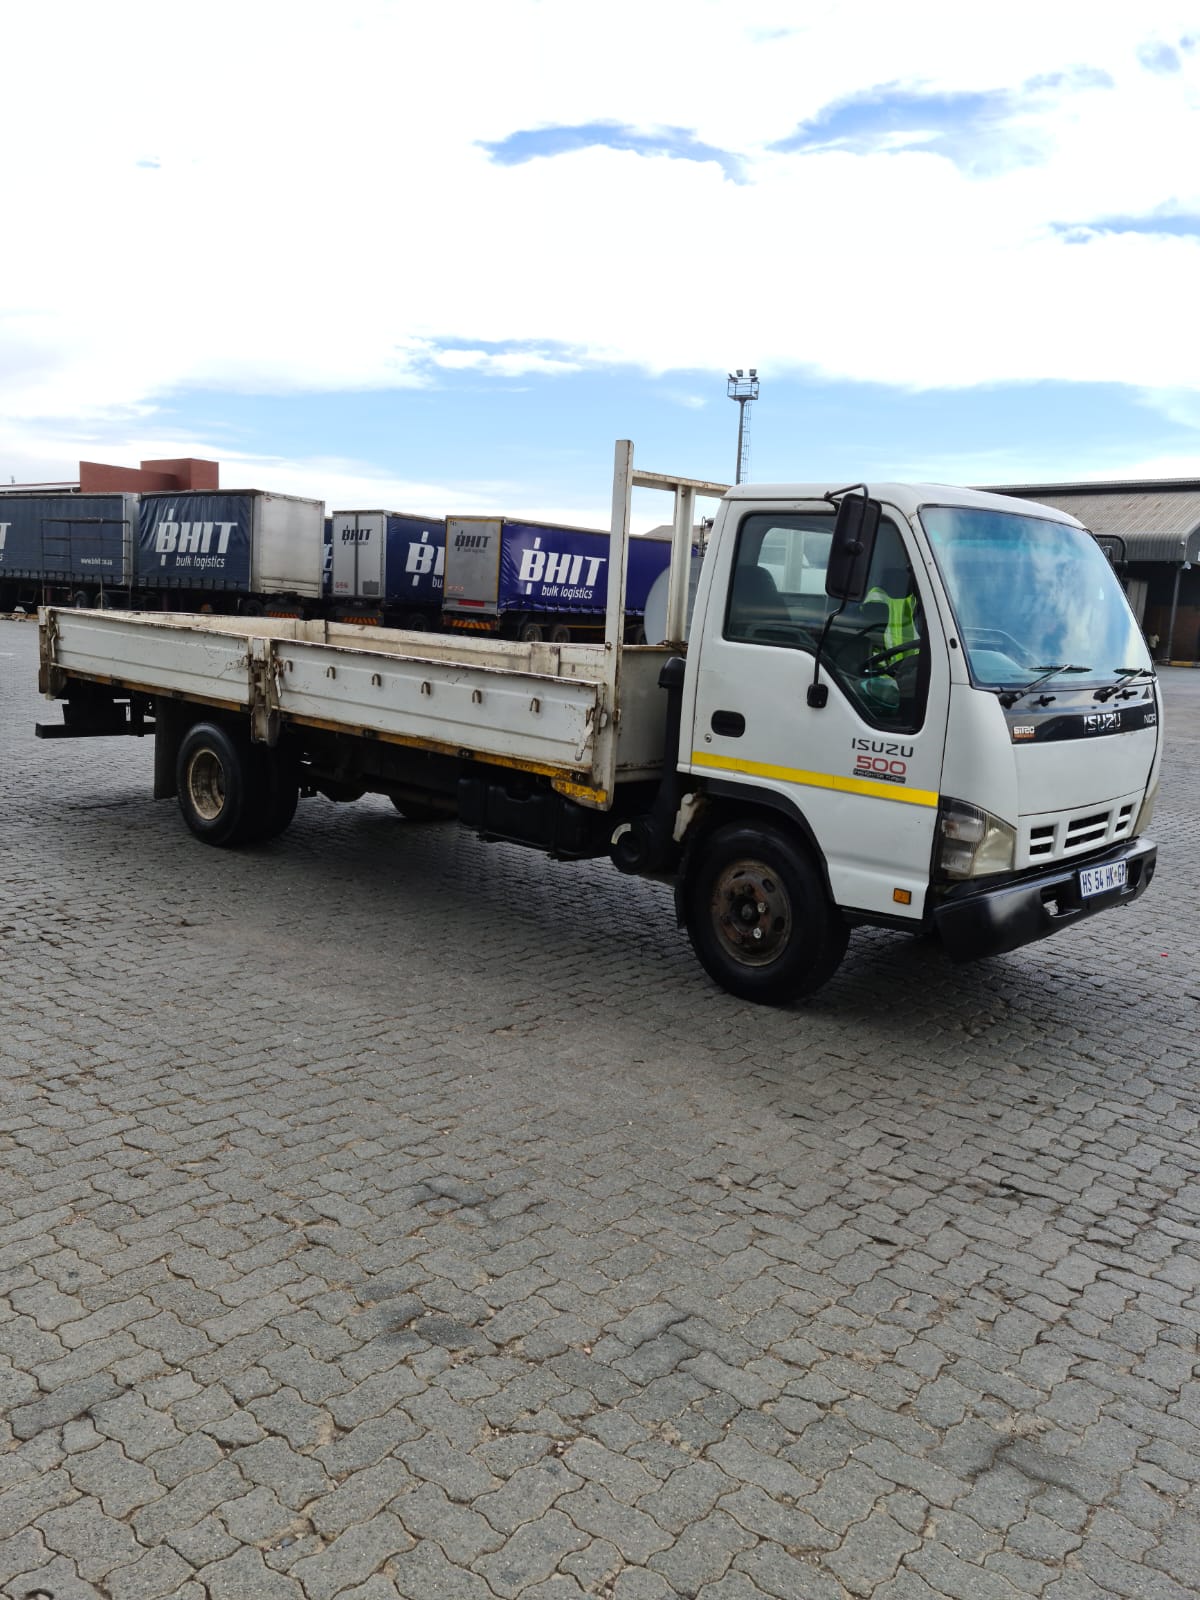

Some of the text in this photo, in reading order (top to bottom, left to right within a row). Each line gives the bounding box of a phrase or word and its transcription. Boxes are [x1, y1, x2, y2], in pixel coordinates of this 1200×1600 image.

[155, 521, 239, 554] BHIT
[341, 528, 373, 542] BHIT
[454, 534, 492, 549] BHIT
[175, 555, 225, 570] bulk logistics
[518, 548, 607, 587] BHIT
[541, 584, 593, 600] bulk logistics
[1083, 712, 1121, 734] ISUZU
[851, 738, 914, 758] ISUZU
[856, 755, 907, 775] 500
[1082, 872, 1092, 894] HS
[1094, 870, 1104, 890] 54
[1117, 863, 1125, 883] GP
